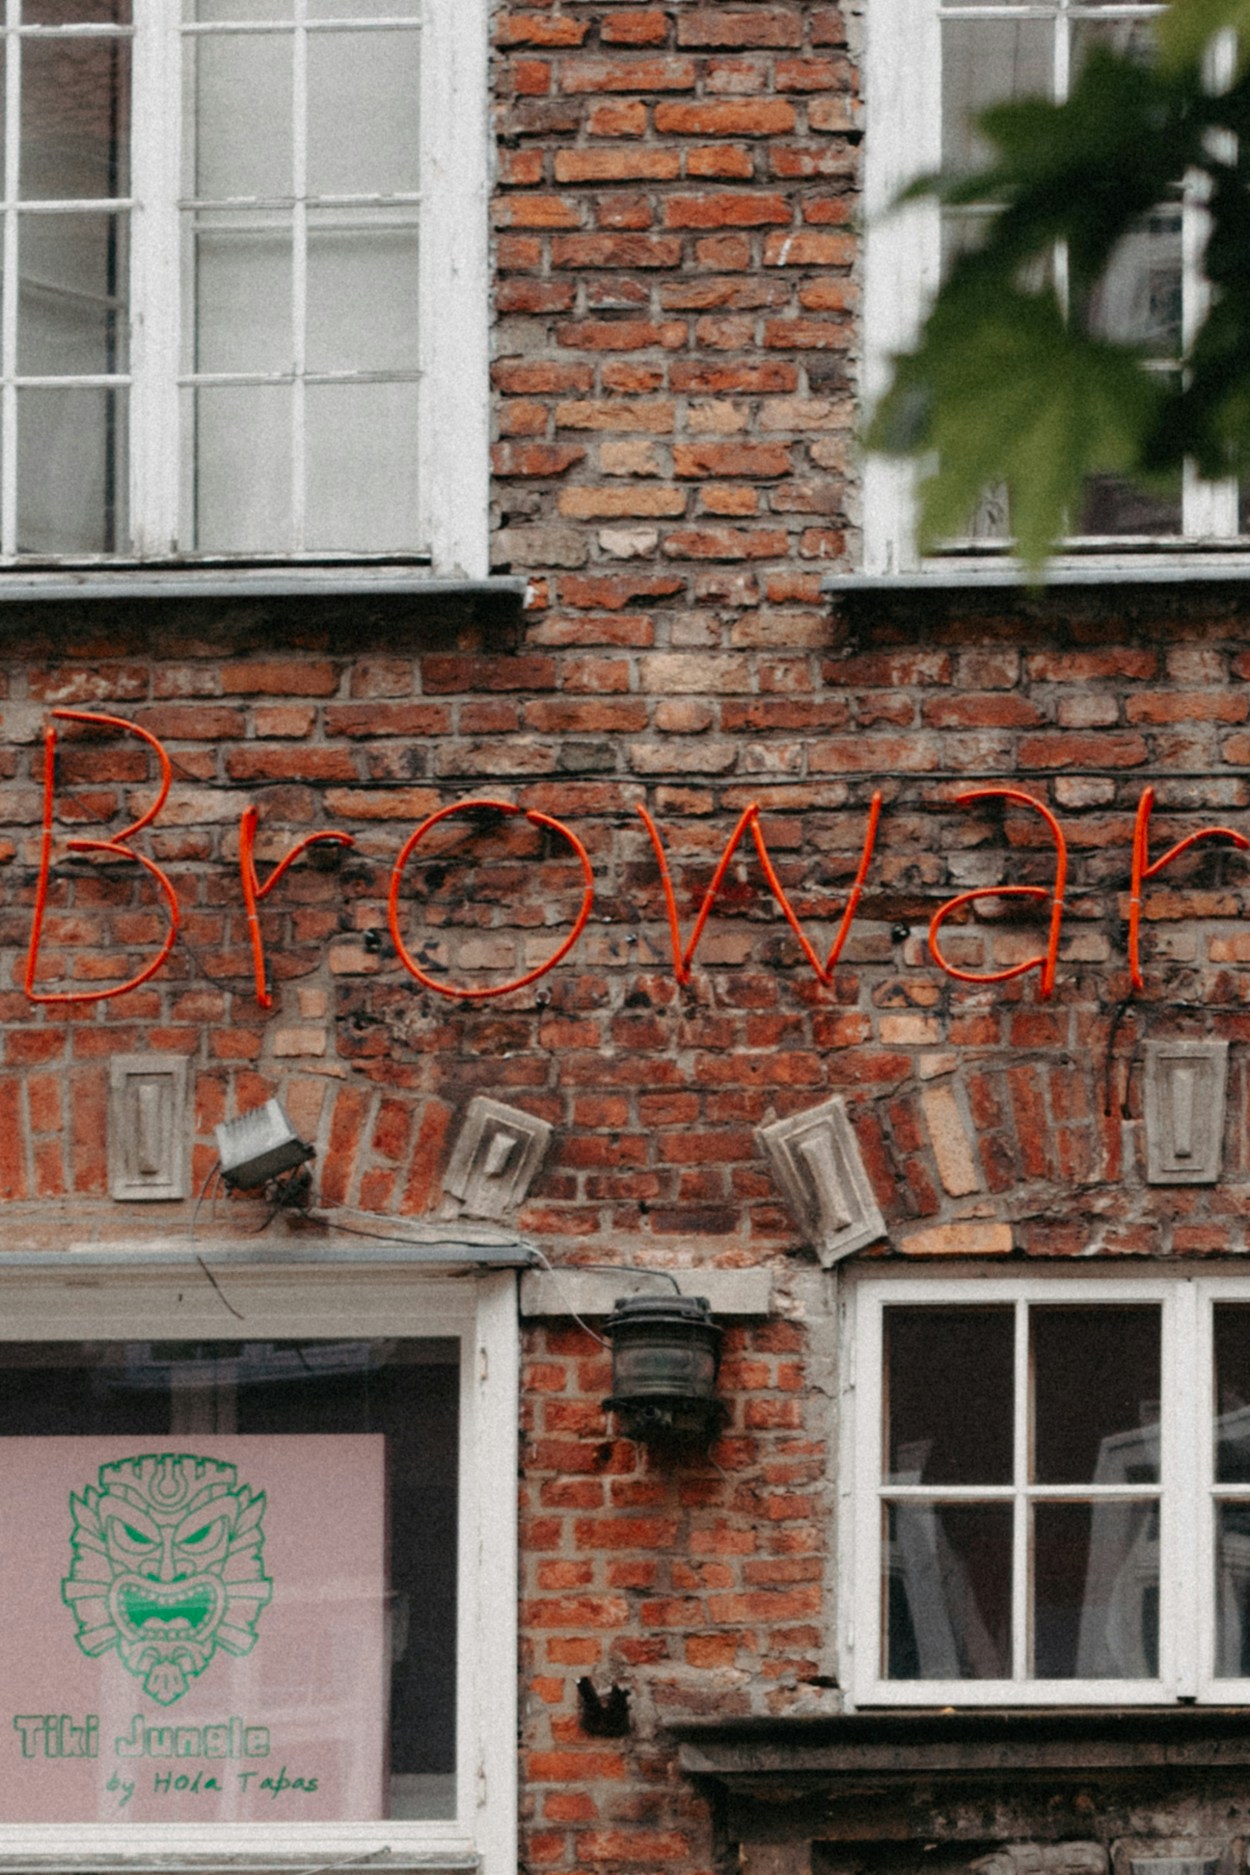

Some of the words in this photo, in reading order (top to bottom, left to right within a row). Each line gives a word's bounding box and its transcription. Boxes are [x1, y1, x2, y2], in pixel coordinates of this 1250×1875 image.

[24, 708, 1250, 1008] Browar
[13, 1714, 99, 1759] Tiki
[114, 1713, 270, 1759] Jungle
[106, 1770, 136, 1807] by
[153, 1771, 222, 1794] Hola
[237, 1765, 319, 1799] Tapas
